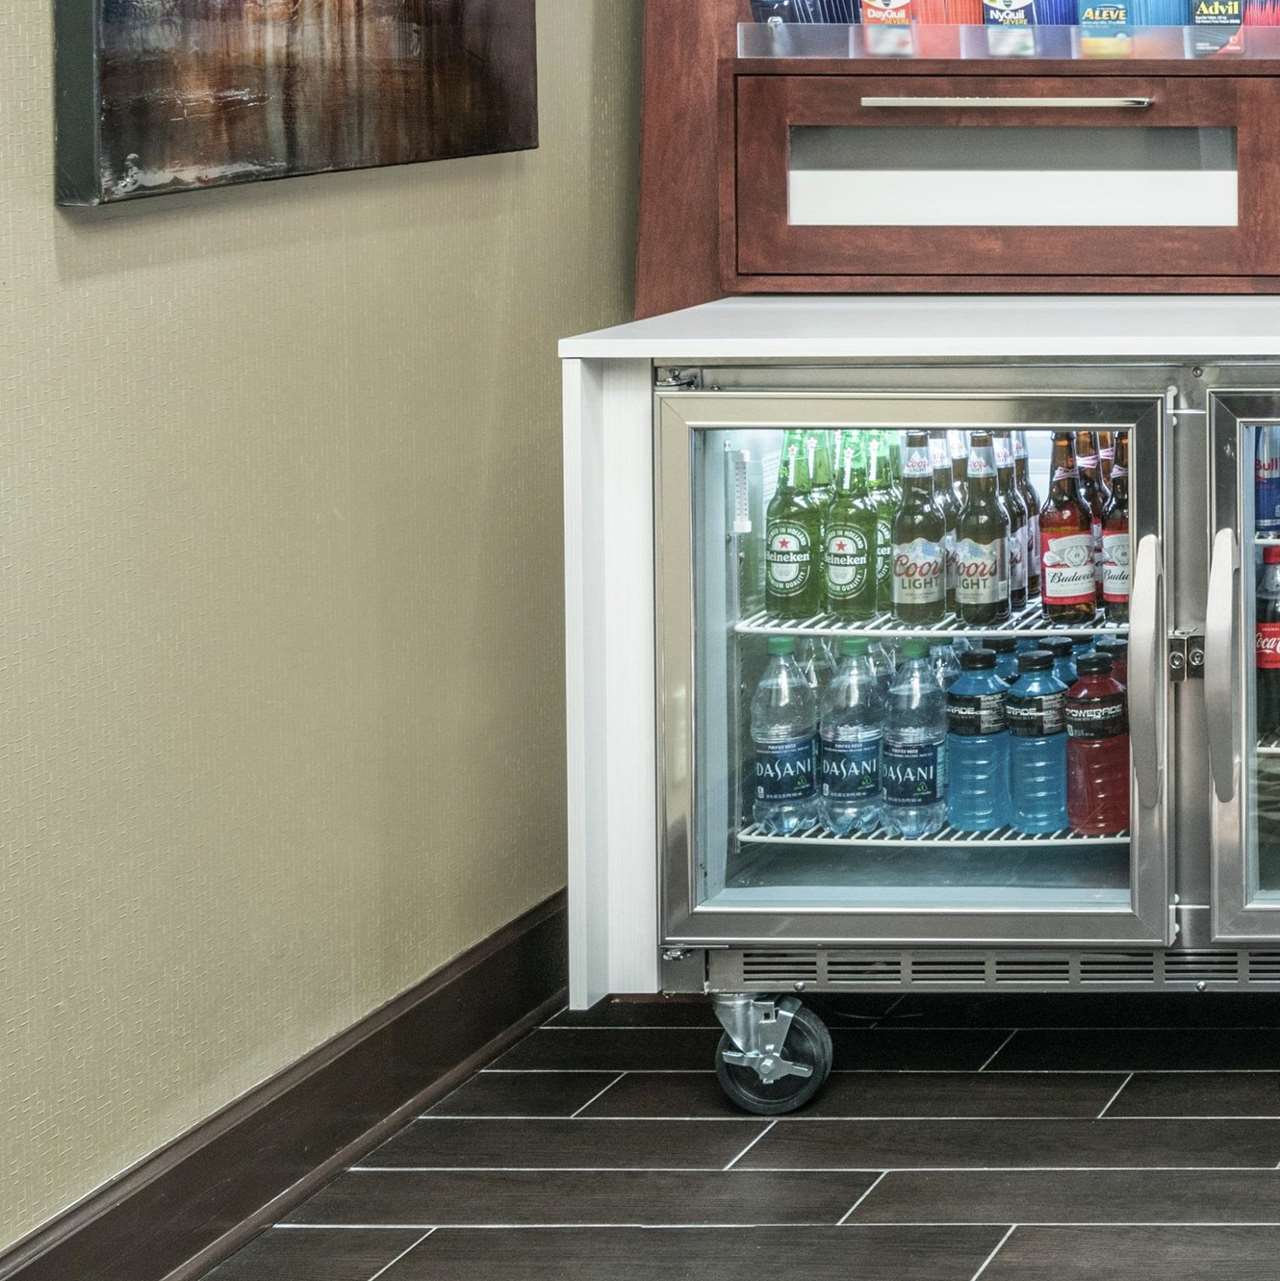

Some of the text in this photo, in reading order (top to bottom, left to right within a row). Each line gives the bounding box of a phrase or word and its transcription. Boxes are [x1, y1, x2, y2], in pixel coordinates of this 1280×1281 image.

[867, 8, 906, 21] DayQuil
[1083, 8, 1127, 21] ALEVE
[1196, 0, 1240, 16] Advil
[990, 9, 1025, 22] NyQuil
[826, 555, 867, 566] eineken
[756, 758, 811, 781] DASANI
[823, 758, 877, 779] DASANI
[882, 763, 934, 784] DASANI
